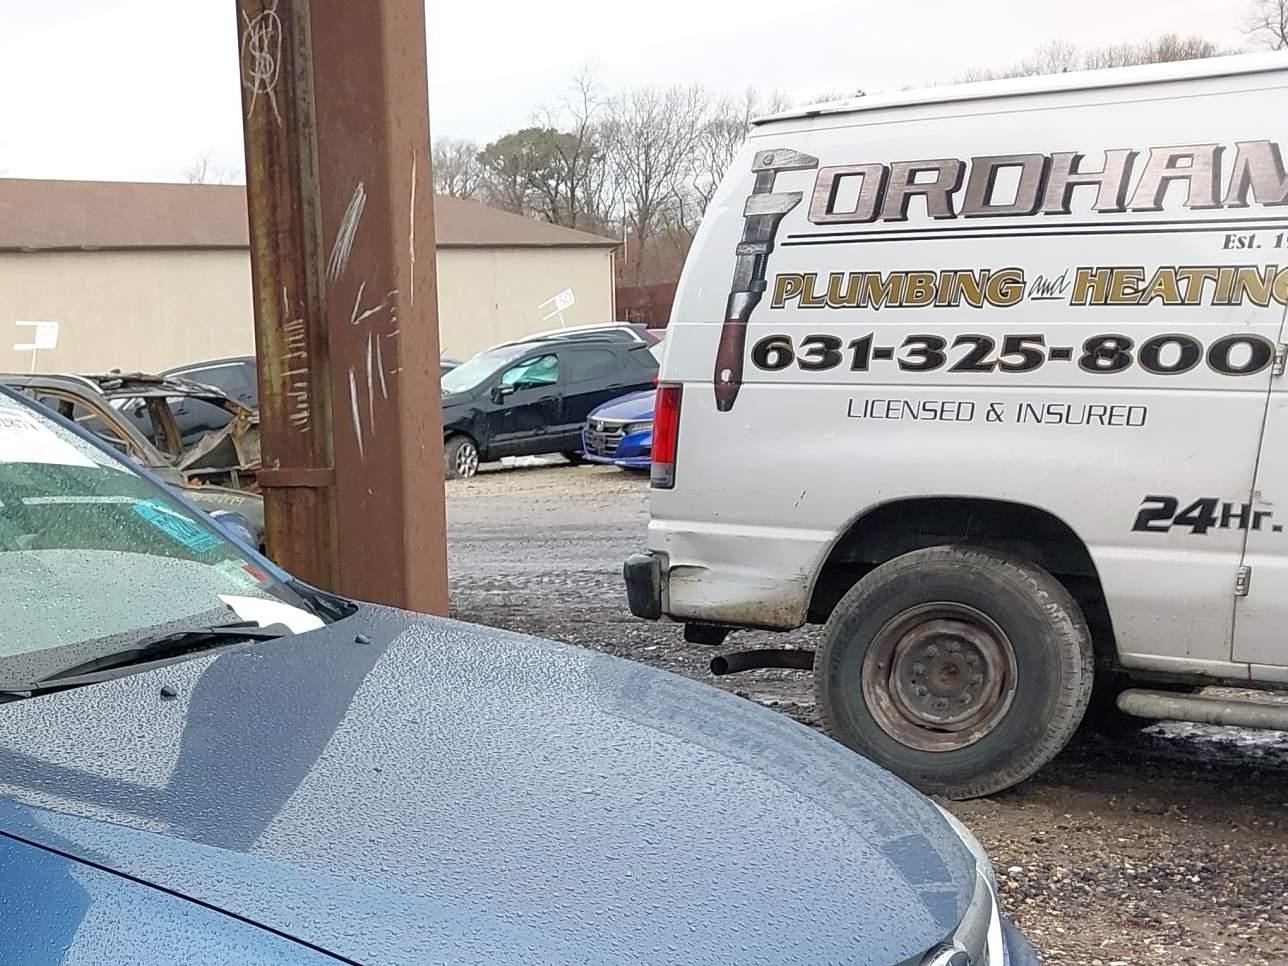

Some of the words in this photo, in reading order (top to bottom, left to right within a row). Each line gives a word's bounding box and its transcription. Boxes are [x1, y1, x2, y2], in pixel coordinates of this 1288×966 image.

[1222, 233, 1261, 249] Est.
[1273, 232, 1288, 248] 1
[771, 268, 1026, 310] PLUMBING
[1028, 268, 1071, 300] and
[751, 331, 1276, 377] 631-325-800
[847, 398, 975, 423] LICENSED
[986, 402, 1004, 423] &
[1016, 403, 1147, 427] INSURED
